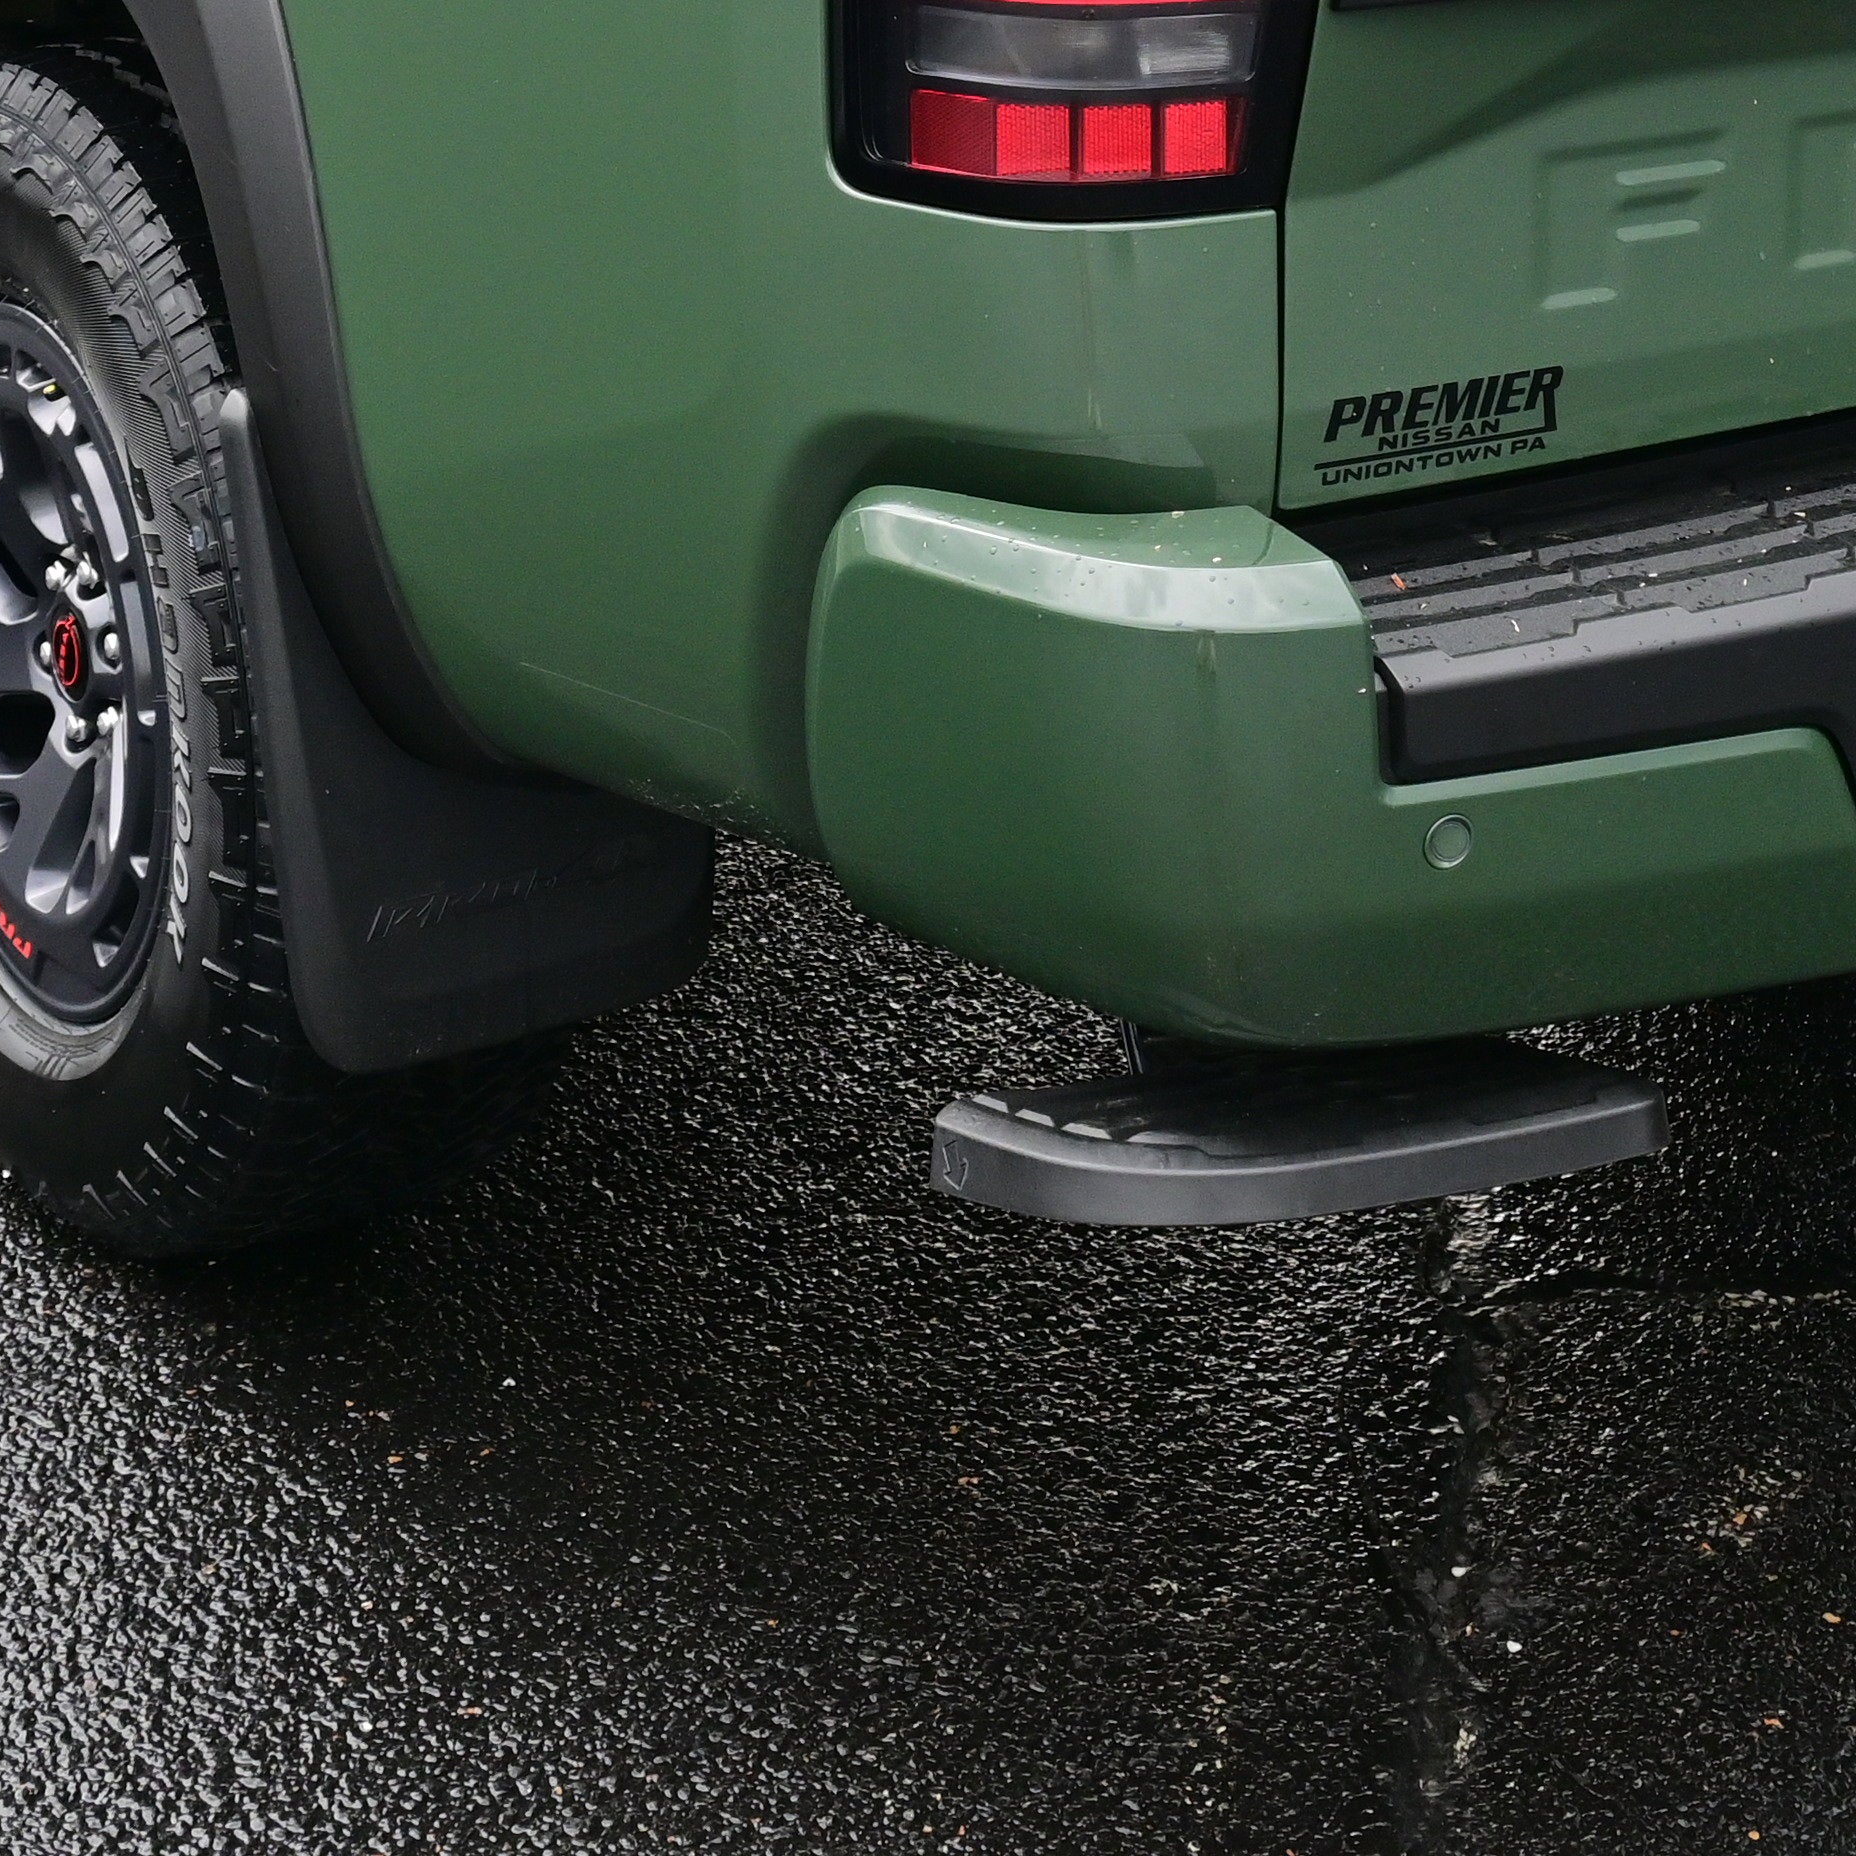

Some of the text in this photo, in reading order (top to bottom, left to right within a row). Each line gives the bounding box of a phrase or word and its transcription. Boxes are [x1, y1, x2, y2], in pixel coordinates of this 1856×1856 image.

[1323, 365, 1564, 443] PREMIER
[1377, 418, 1501, 452] NISSAN
[1321, 436, 1546, 486] UNIONTOWN PA
